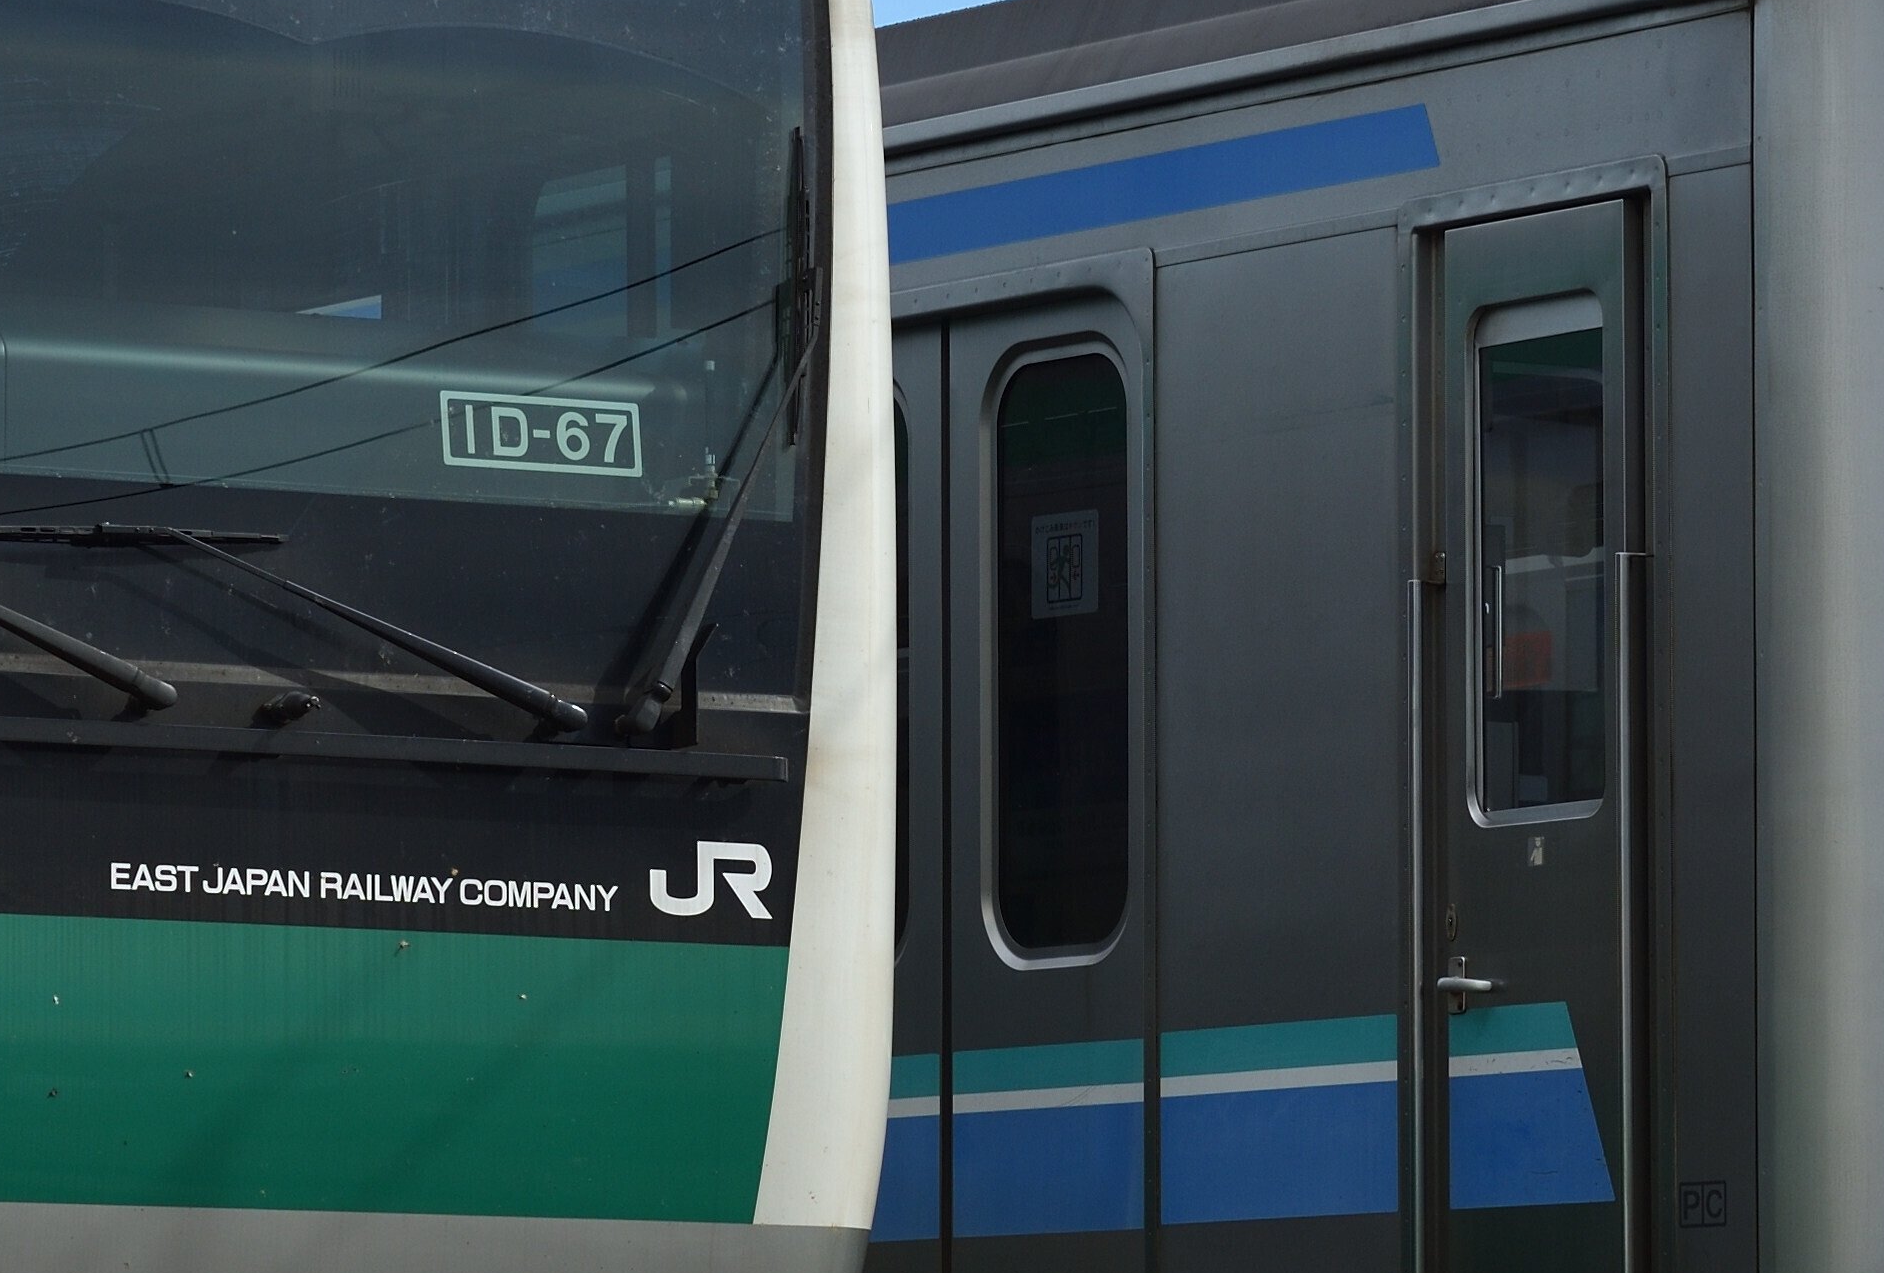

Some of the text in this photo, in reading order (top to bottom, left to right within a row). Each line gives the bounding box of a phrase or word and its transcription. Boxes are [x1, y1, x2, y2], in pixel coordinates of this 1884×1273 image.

[463, 402, 629, 465] ID-67
[109, 861, 619, 914] EAST JAPAN RAILWAY COMPANY
[648, 840, 774, 920] JR
